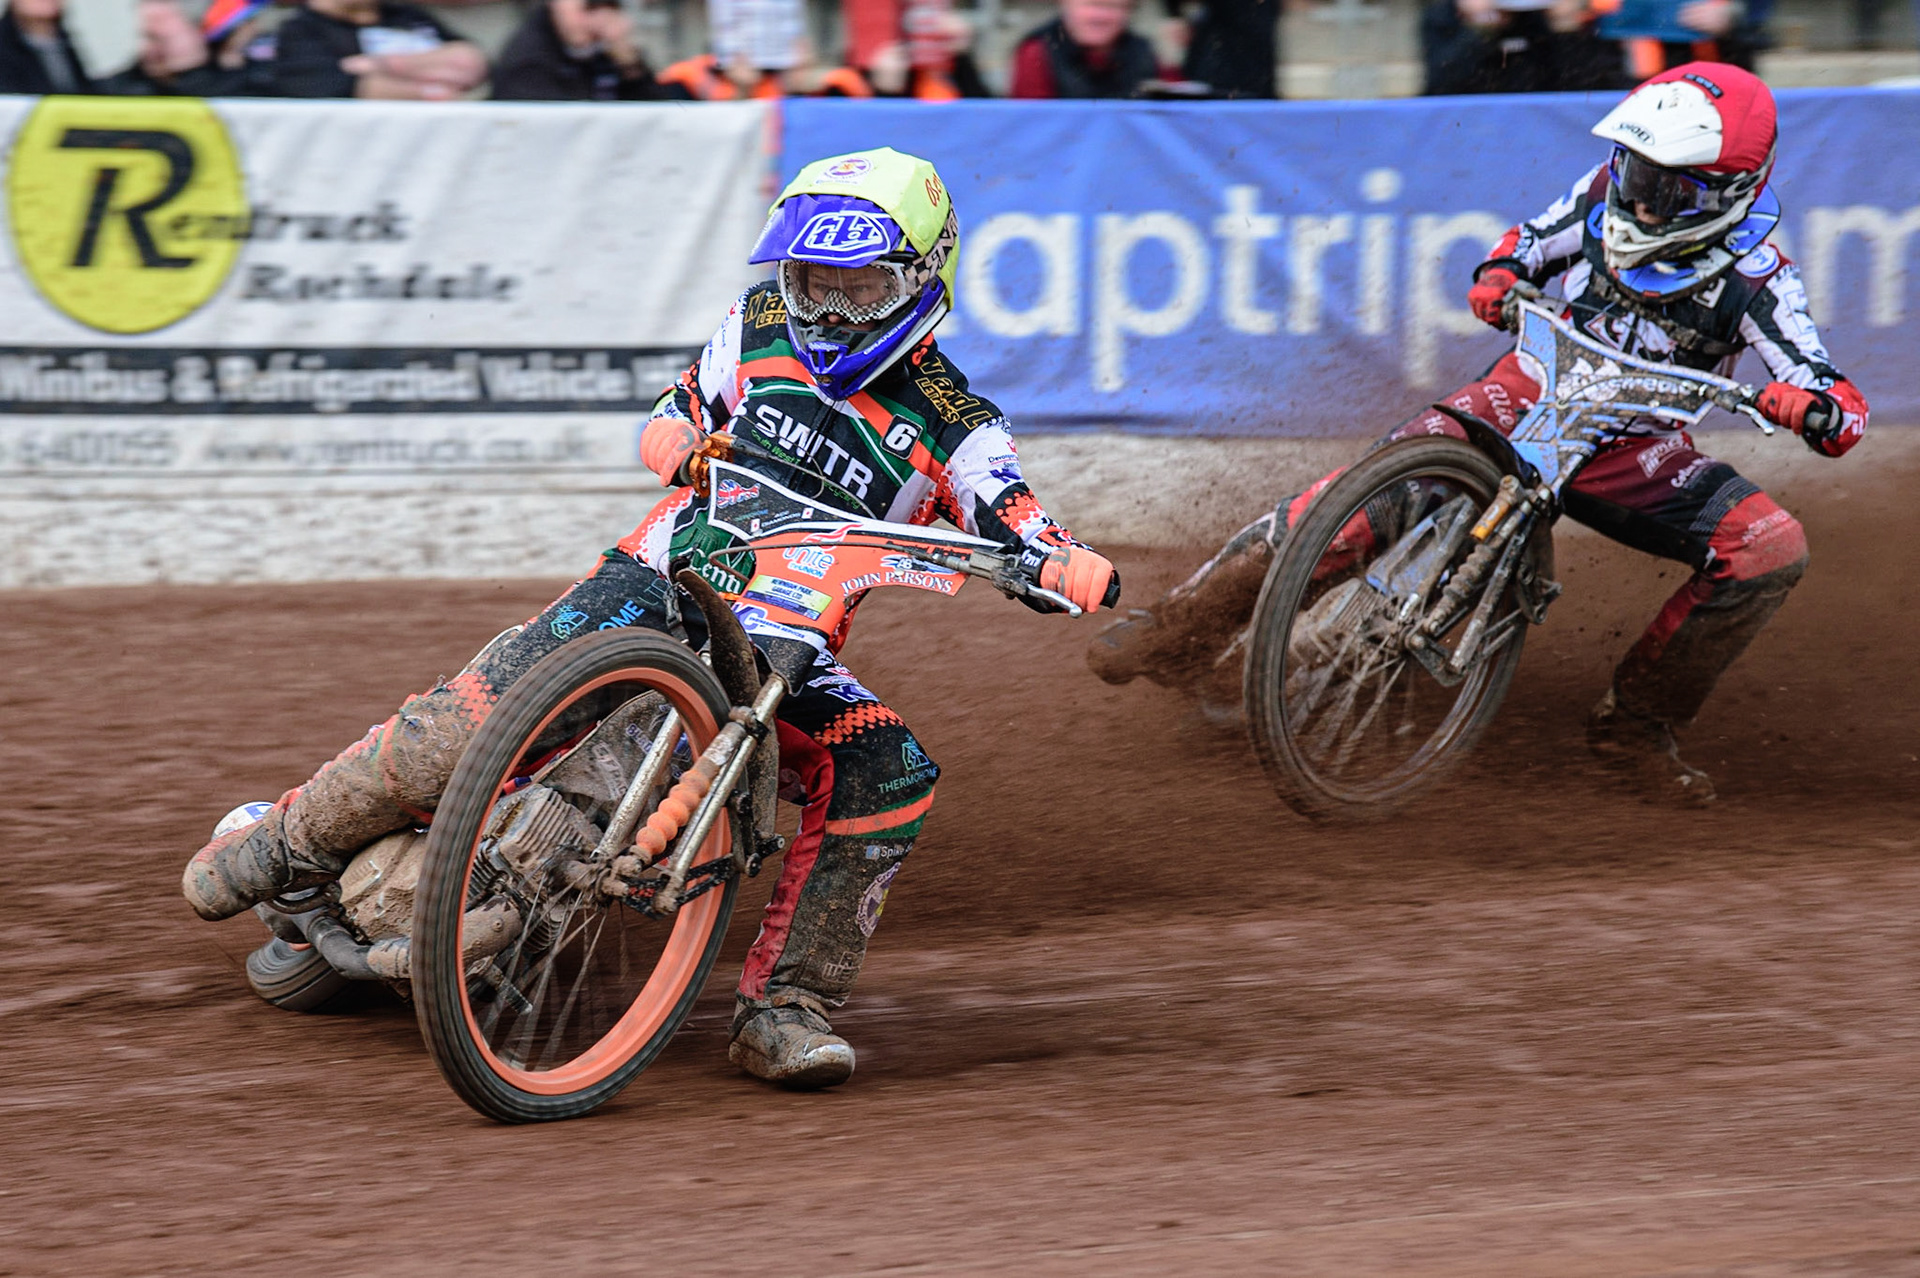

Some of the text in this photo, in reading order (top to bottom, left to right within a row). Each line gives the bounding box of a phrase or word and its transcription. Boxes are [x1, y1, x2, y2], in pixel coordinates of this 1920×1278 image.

[884, 422, 919, 452] 6
[840, 571, 954, 597] JOHN PARSONS
